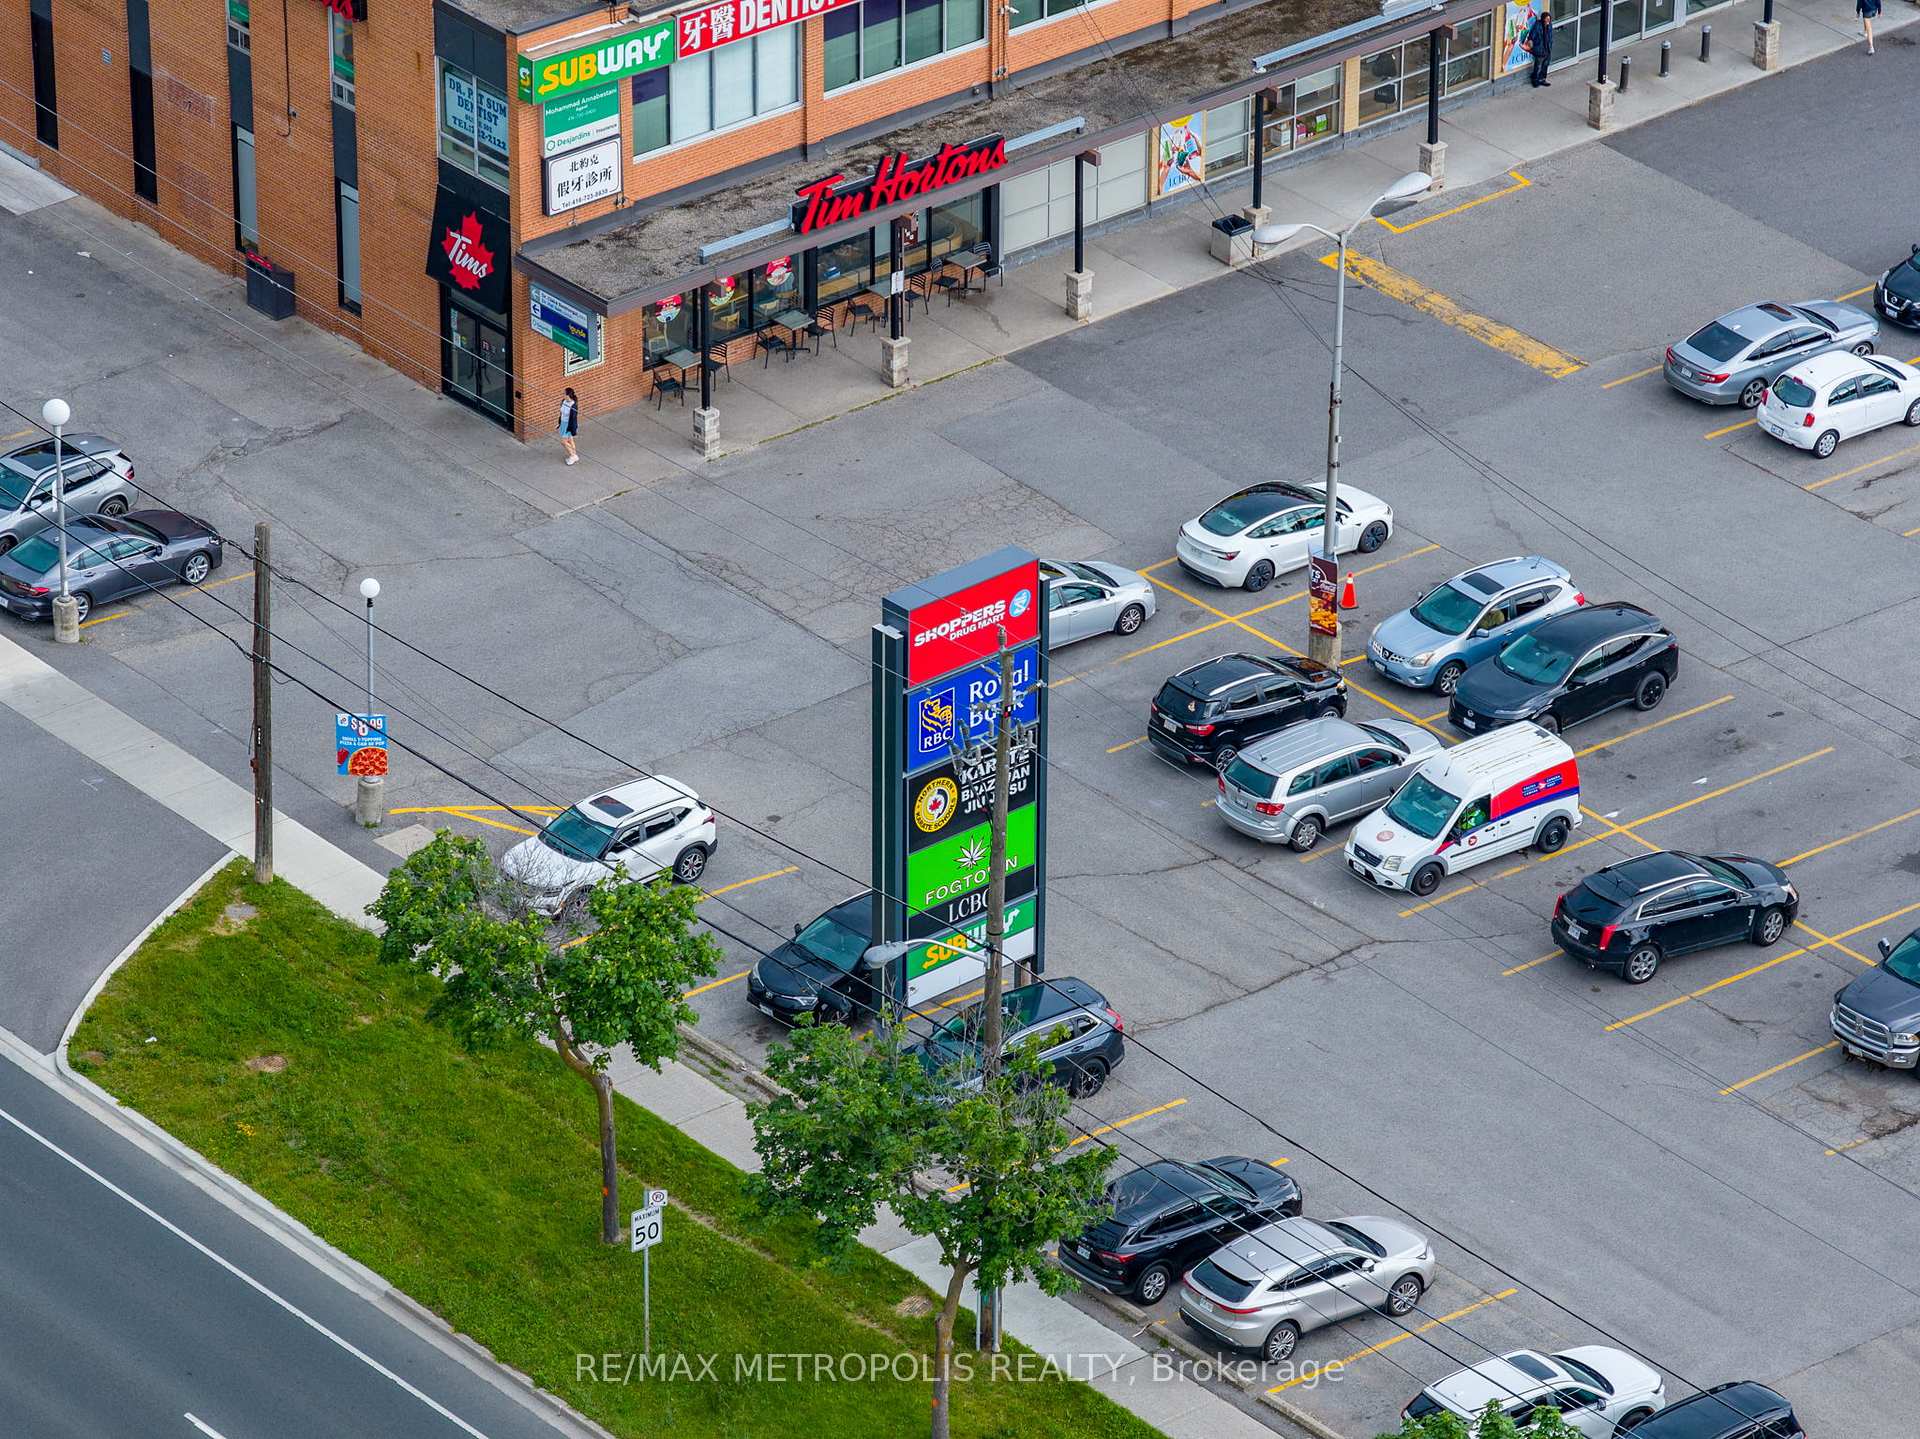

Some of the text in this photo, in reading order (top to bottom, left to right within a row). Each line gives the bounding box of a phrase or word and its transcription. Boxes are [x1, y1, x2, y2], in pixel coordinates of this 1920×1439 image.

[681, 0, 836, 50] 牙醫 DENT
[538, 28, 671, 95] SUBWAY
[449, 78, 507, 118] DR. PT SUM
[557, 166, 613, 198] 假牙診所
[798, 137, 1009, 234] Tim Hortons
[448, 231, 488, 278] Tims
[914, 600, 1006, 647] SHOPPERS
[949, 612, 1006, 641] DRUG MART
[969, 660, 1029, 703] Roal
[969, 689, 1025, 728] Bak
[924, 728, 951, 749] RBC
[960, 749, 1030, 785] KARTE
[961, 765, 1031, 802] BRAZIAN
[918, 780, 953, 803] NORTHERN
[964, 779, 1027, 814] JIU JSU
[925, 856, 1018, 905] FOGTON
[922, 908, 1020, 969] SUBWY
[635, 1208, 660, 1221] MAXIMUM
[635, 1222, 659, 1245] 50
